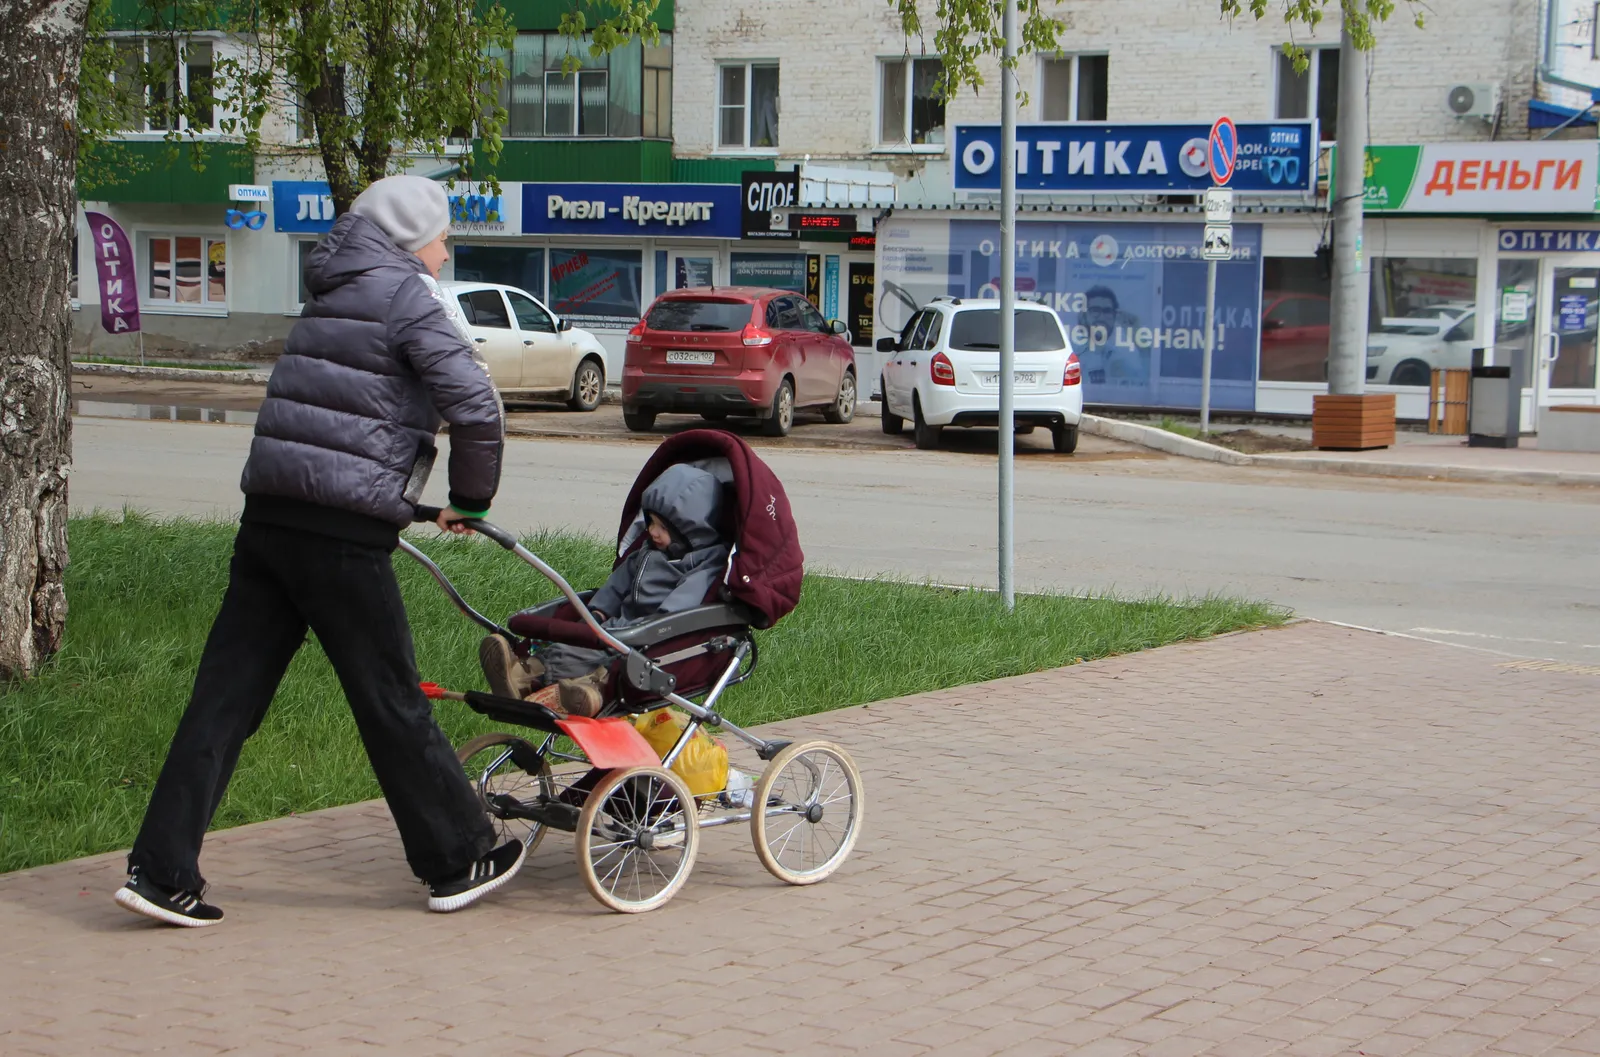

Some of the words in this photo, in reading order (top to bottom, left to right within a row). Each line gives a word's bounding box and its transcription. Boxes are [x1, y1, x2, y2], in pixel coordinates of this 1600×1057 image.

[1270, 132, 1300, 144] ОПТИКА
[1424, 159, 1584, 196] ДЕНЬГИ
[236, 187, 268, 198] ОПТИКА
[979, 240, 1079, 258] ОТИКА
[1123, 244, 1186, 258] ДОКТОР
[100, 223, 128, 332] ОПТИКА
